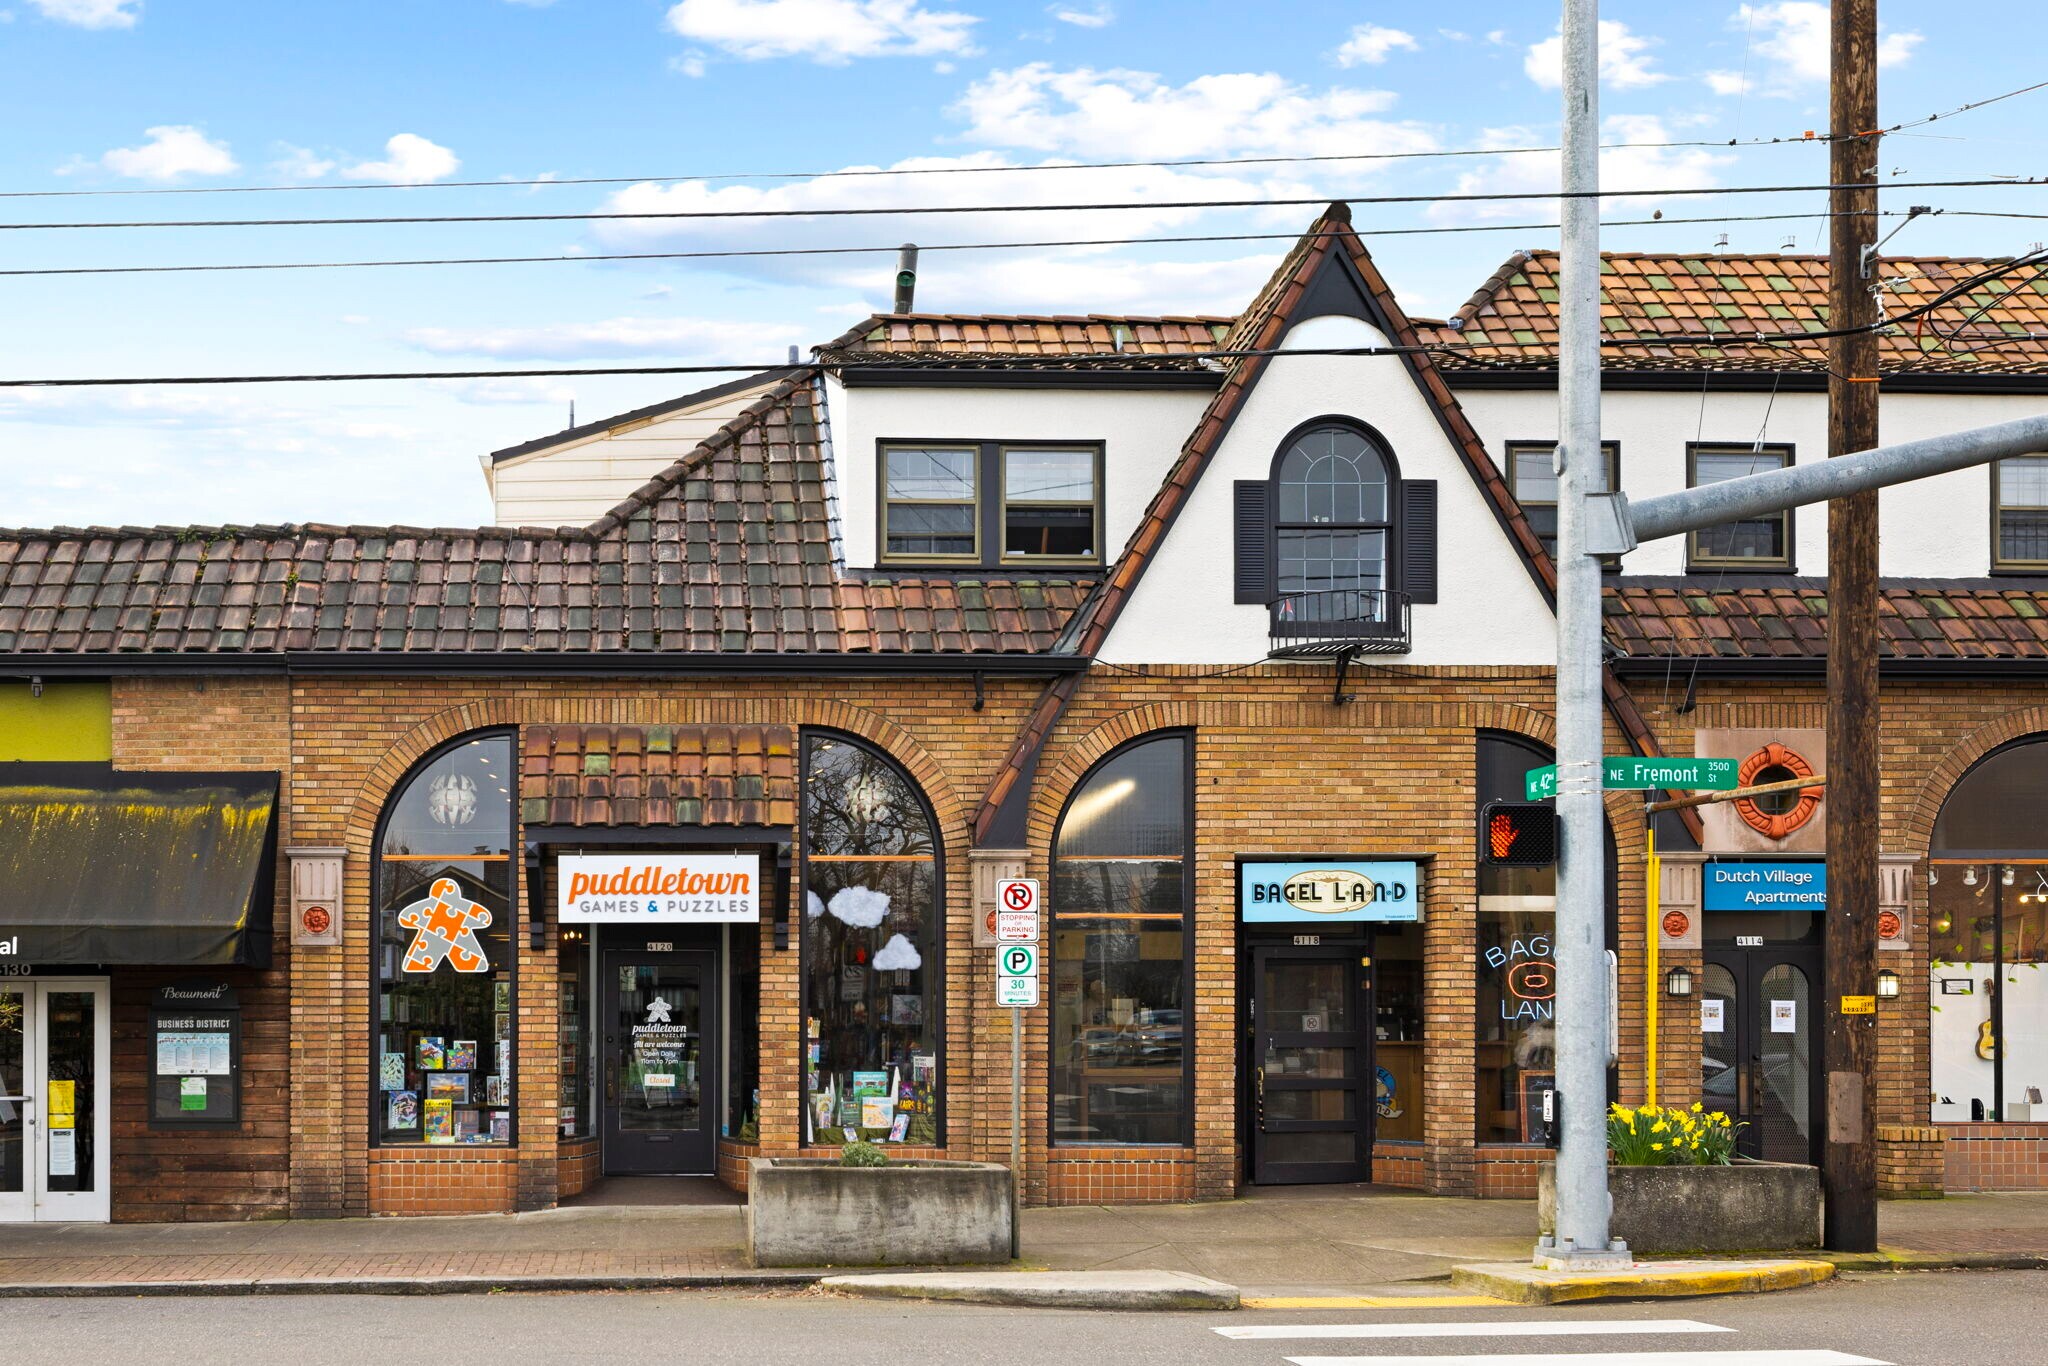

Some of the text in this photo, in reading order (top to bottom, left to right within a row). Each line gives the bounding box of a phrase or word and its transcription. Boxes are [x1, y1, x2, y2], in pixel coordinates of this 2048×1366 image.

[1708, 762, 1730, 771] 3500
[1610, 764, 1717, 783] NE Fremont St
[1530, 781, 1538, 793] NE
[1715, 870, 1813, 885] Dutch Village
[568, 866, 750, 905] puddletown
[1253, 882, 1323, 903] BAGEL
[579, 900, 750, 913] GAMES & PUZZLES
[1295, 936, 1320, 945] 4118
[1737, 937, 1763, 945] 4114
[647, 943, 672, 951] 4120
[1485, 936, 1557, 968] BAG
[0, 964, 31, 976] 130
[1011, 979, 1025, 989] 30
[161, 983, 229, 999] Beaumont
[157, 1019, 231, 1029] BUSINESS DISTRICT
[632, 1024, 687, 1035] puddletown
